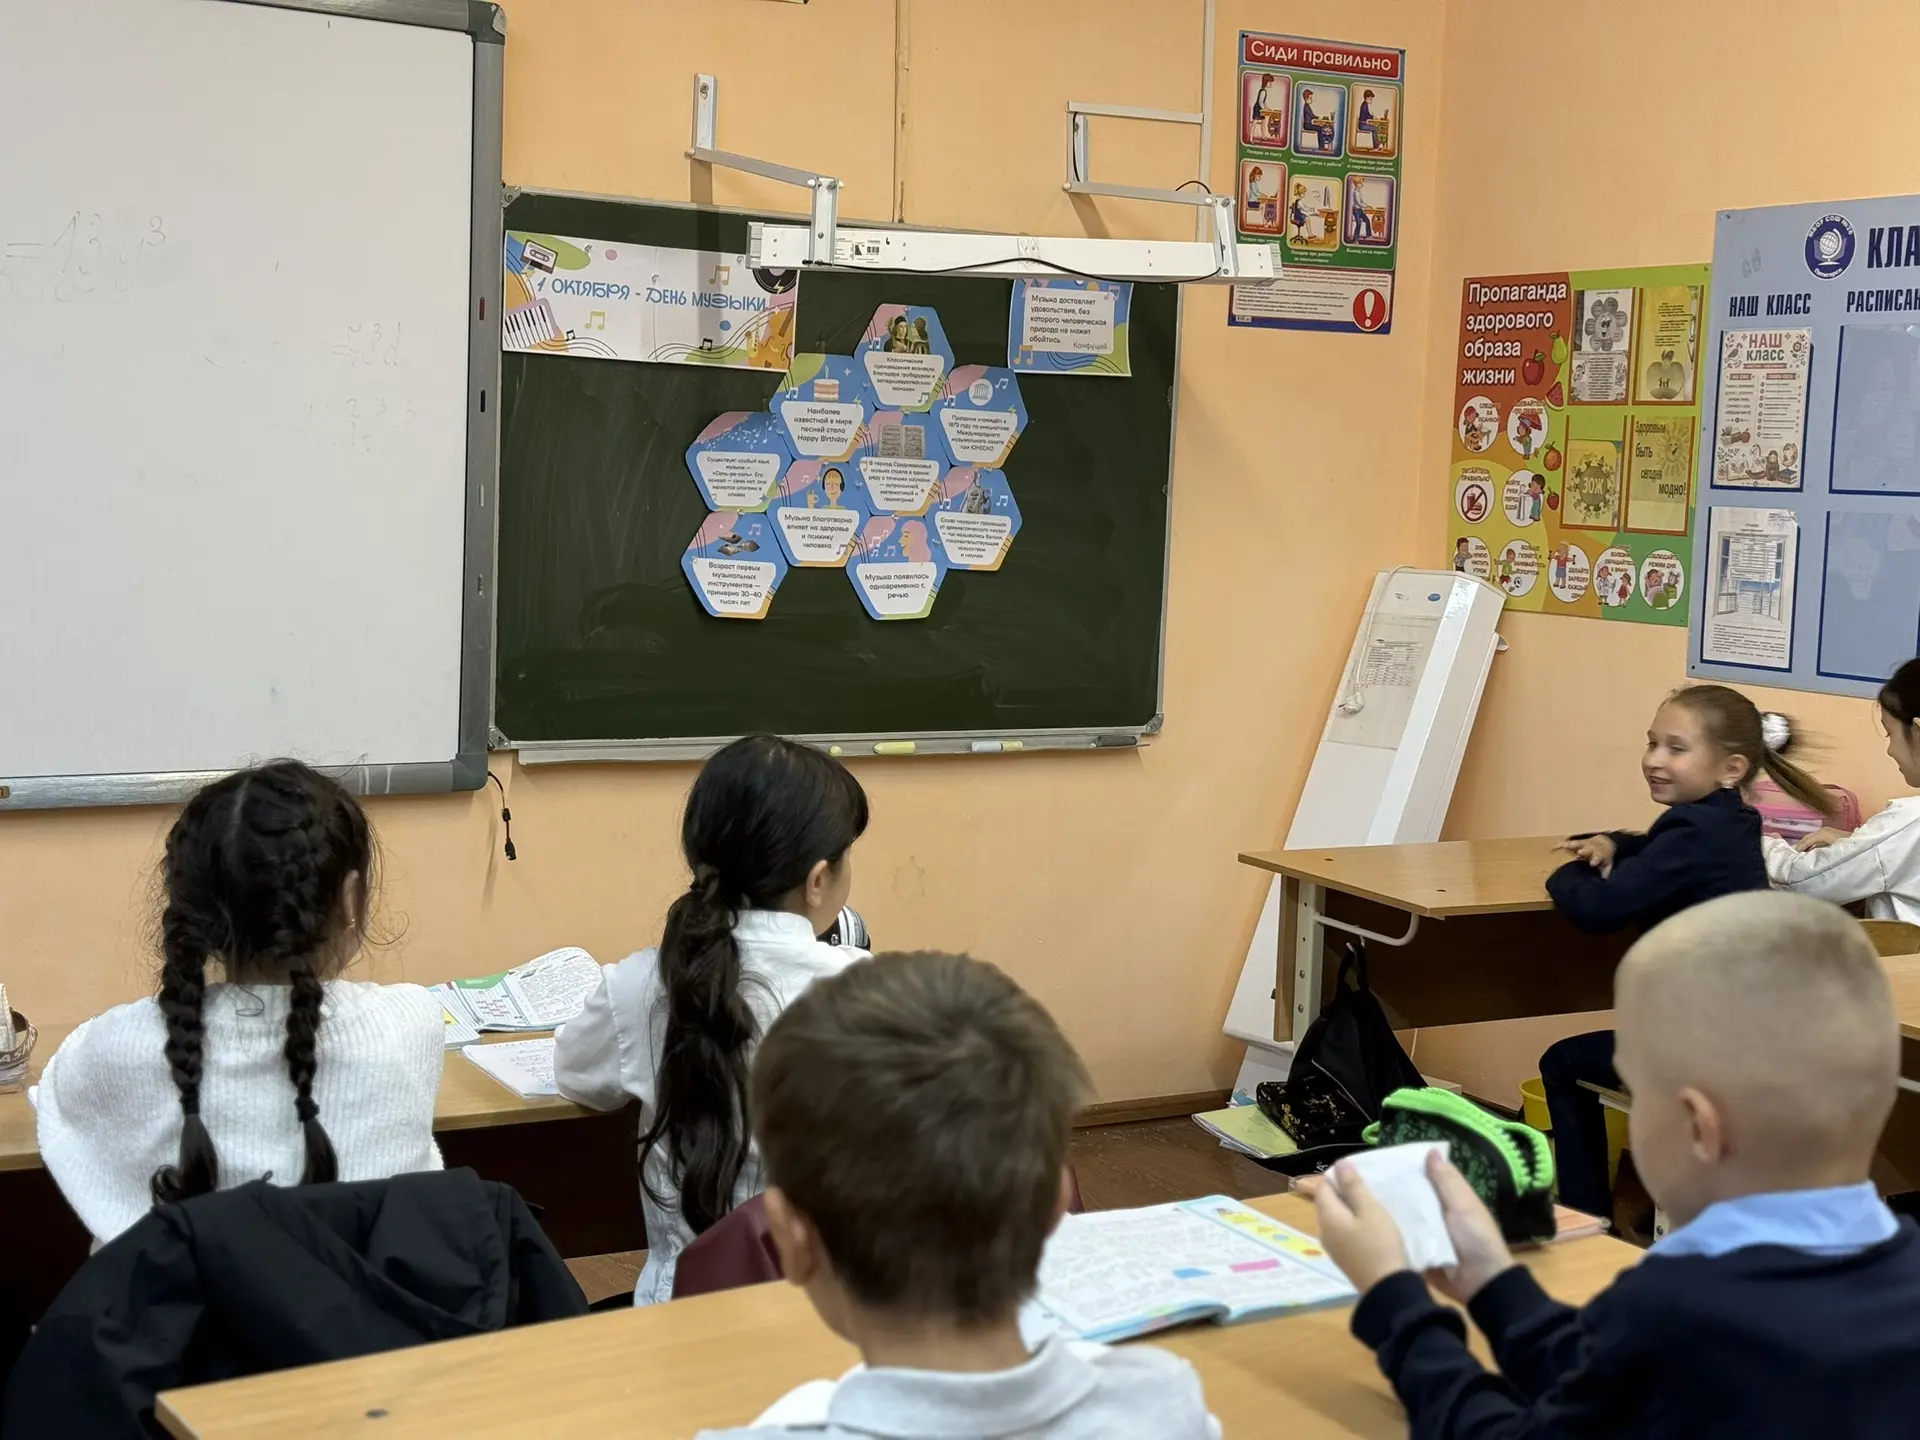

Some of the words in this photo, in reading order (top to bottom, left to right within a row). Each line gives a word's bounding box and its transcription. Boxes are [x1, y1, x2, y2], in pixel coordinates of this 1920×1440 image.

[1251, 40, 1298, 62] Сиди
[1303, 49, 1392, 72] правильно
[552, 278, 630, 300] ОКТЯБРЯ
[645, 287, 686, 306] ДЕНЬ
[692, 292, 766, 311] МУЗЫКИ
[1032, 295, 1057, 304] Музыка
[1468, 282, 1567, 307] Пропаганда
[1031, 306, 1077, 315] удовольствие,
[1729, 296, 1758, 318] НАШ
[1766, 293, 1812, 316] КЛАСС
[1061, 318, 1106, 326] человеческая
[1466, 311, 1554, 336] здорового
[1030, 327, 1058, 335] природа
[1029, 336, 1060, 344] обойтись
[1749, 333, 1782, 349] НАШ
[1073, 342, 1107, 351] Конфуций
[1464, 338, 1521, 362] образа
[1746, 349, 1785, 362] класс
[1462, 368, 1515, 386] жизни
[798, 435, 819, 443] Happy
[821, 436, 848, 444] Birthday
[1636, 443, 1652, 457] быть
[1583, 476, 1604, 495] ЗОЖ
[784, 514, 810, 522] Музыка
[709, 562, 735, 570] Возраст
[712, 572, 756, 580] музыкальных
[708, 581, 752, 589] инструментов
